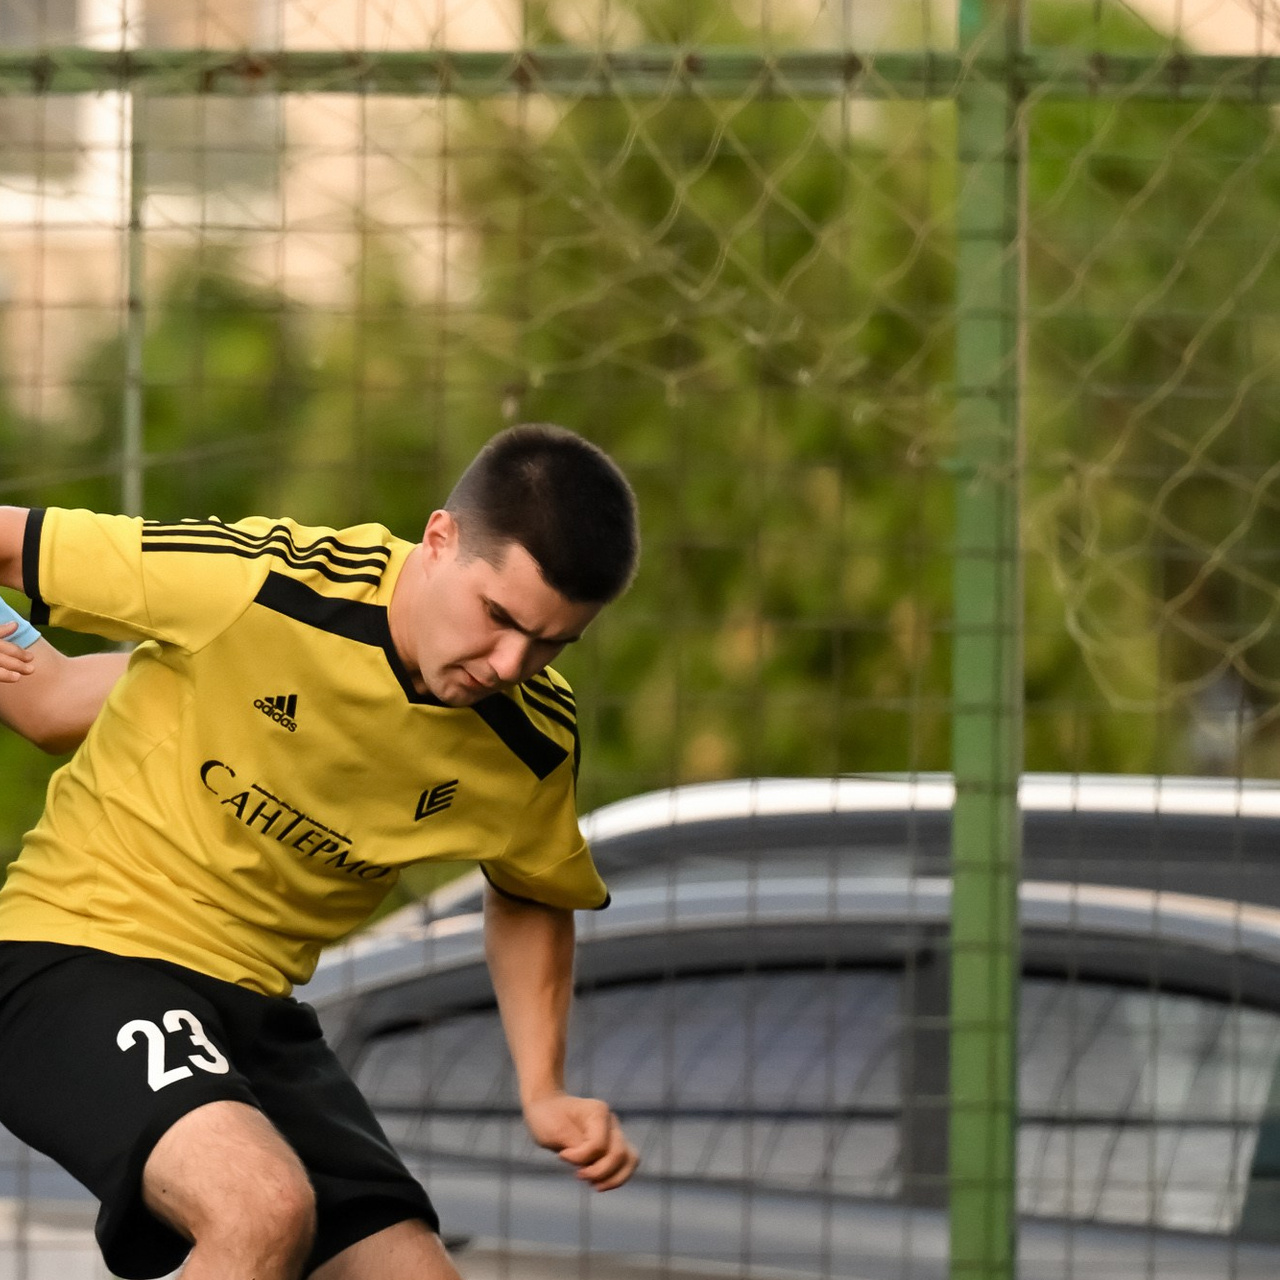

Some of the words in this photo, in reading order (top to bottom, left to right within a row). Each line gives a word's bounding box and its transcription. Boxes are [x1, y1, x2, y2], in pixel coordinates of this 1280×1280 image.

[253, 699, 297, 732] adidas
[200, 760, 392, 880] САНТЕРМО
[116, 1009, 230, 1092] 23
